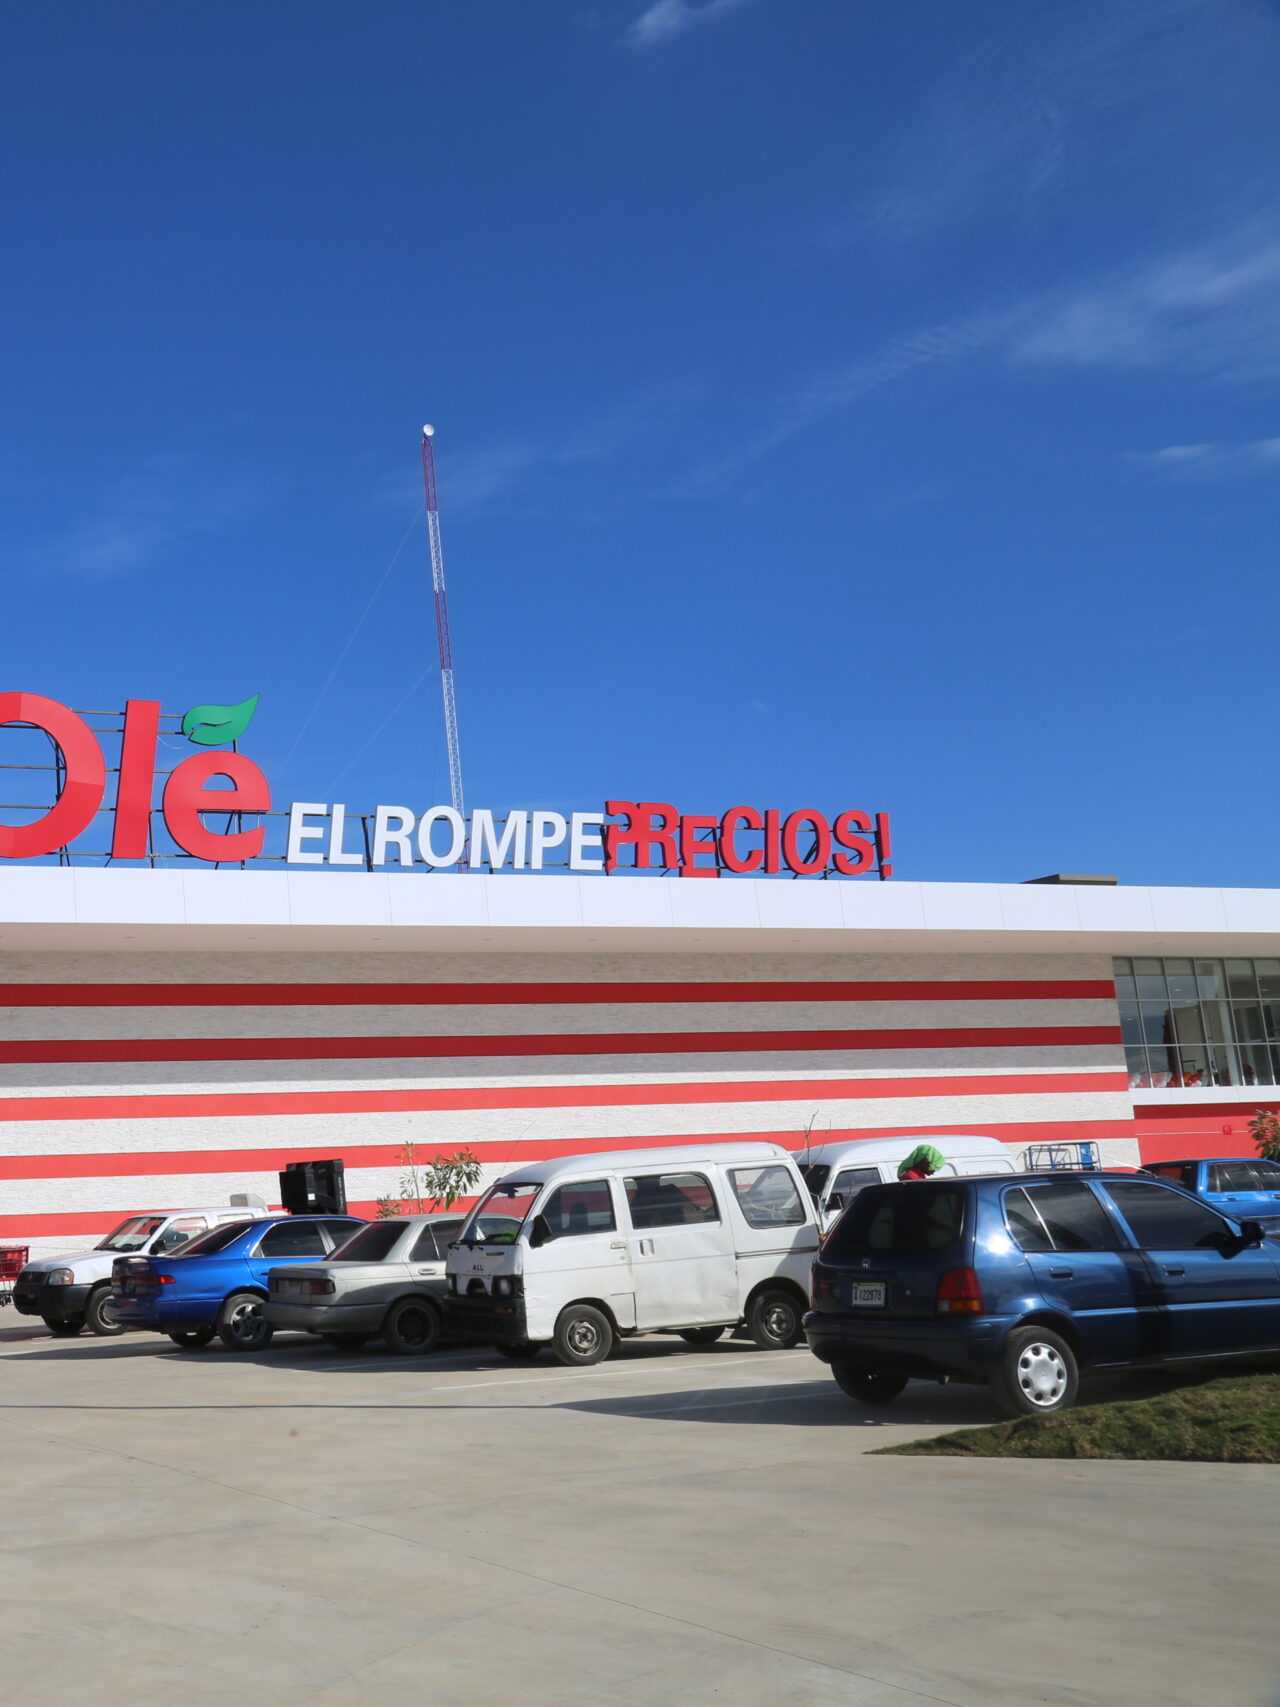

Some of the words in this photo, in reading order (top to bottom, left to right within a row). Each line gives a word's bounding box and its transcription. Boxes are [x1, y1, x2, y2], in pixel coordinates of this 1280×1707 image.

[286, 802, 364, 865] EL
[372, 805, 605, 870] ROMPE
[605, 800, 893, 878] PRECIOS!
